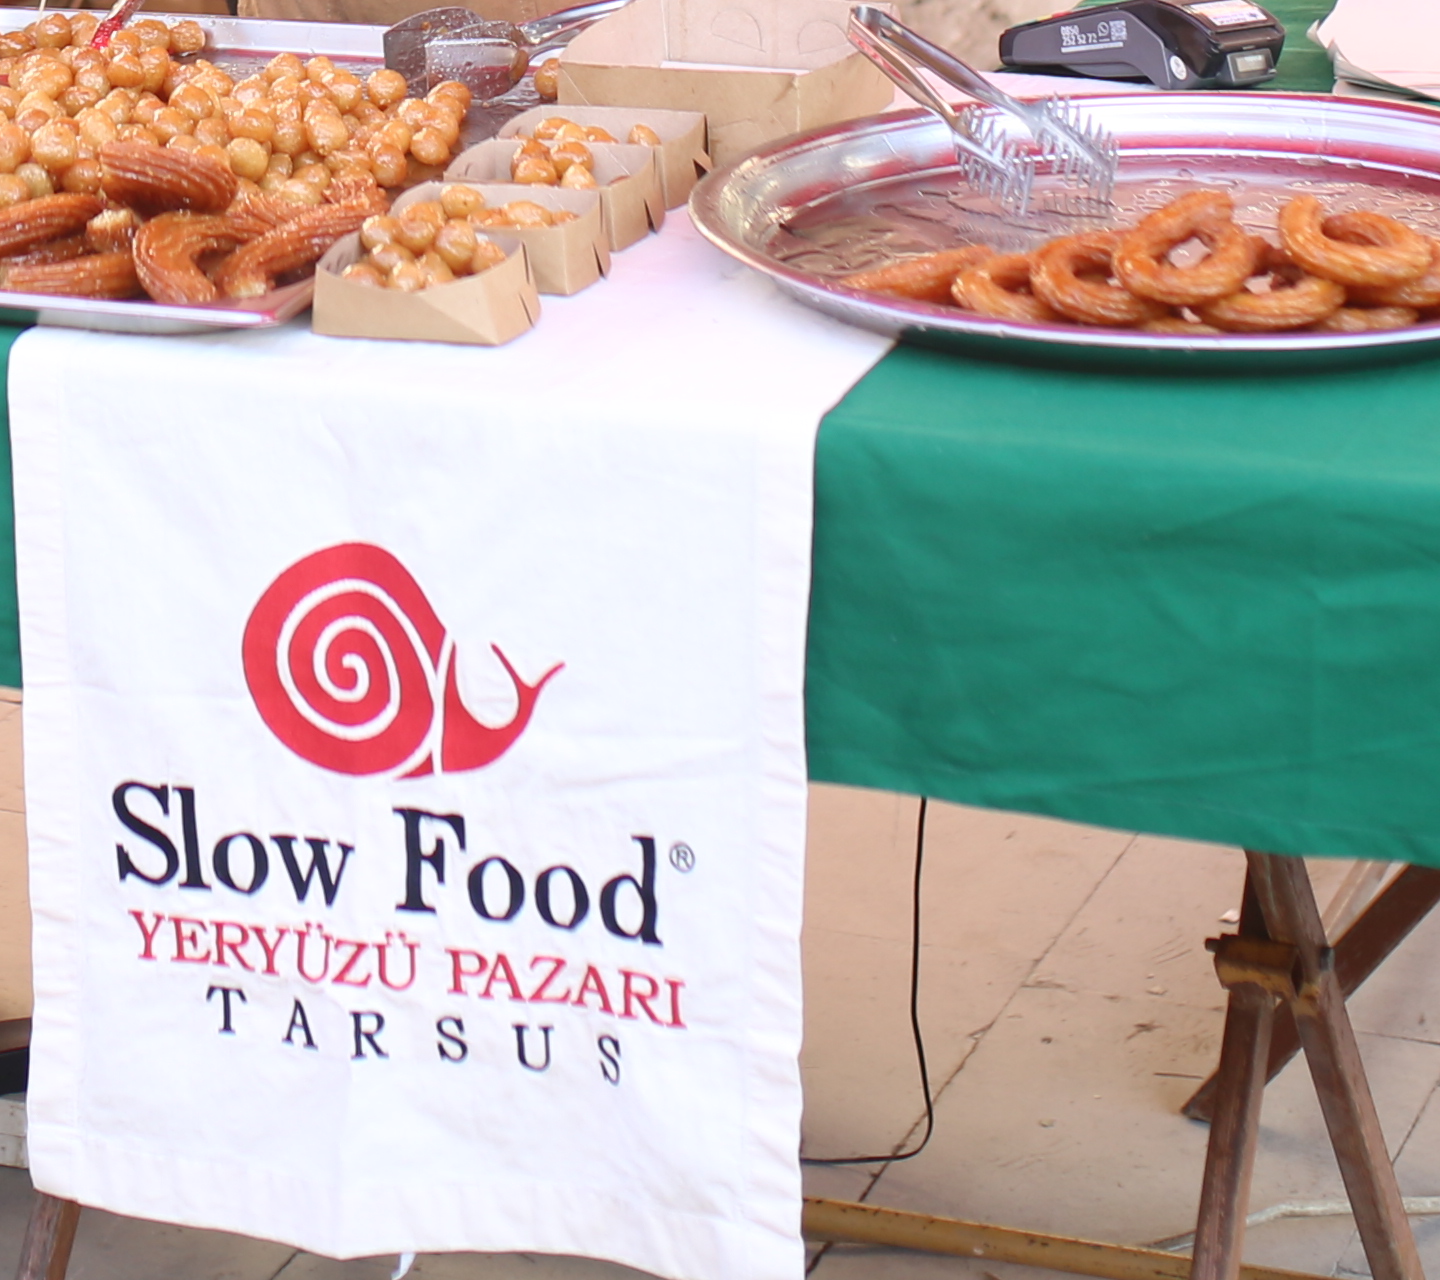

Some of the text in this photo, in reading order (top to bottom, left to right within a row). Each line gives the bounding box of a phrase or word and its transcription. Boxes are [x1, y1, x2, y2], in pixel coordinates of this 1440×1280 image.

[112, 780, 355, 906] Slow
[128, 910, 688, 1029] YERYÜZÜ PAZARI
